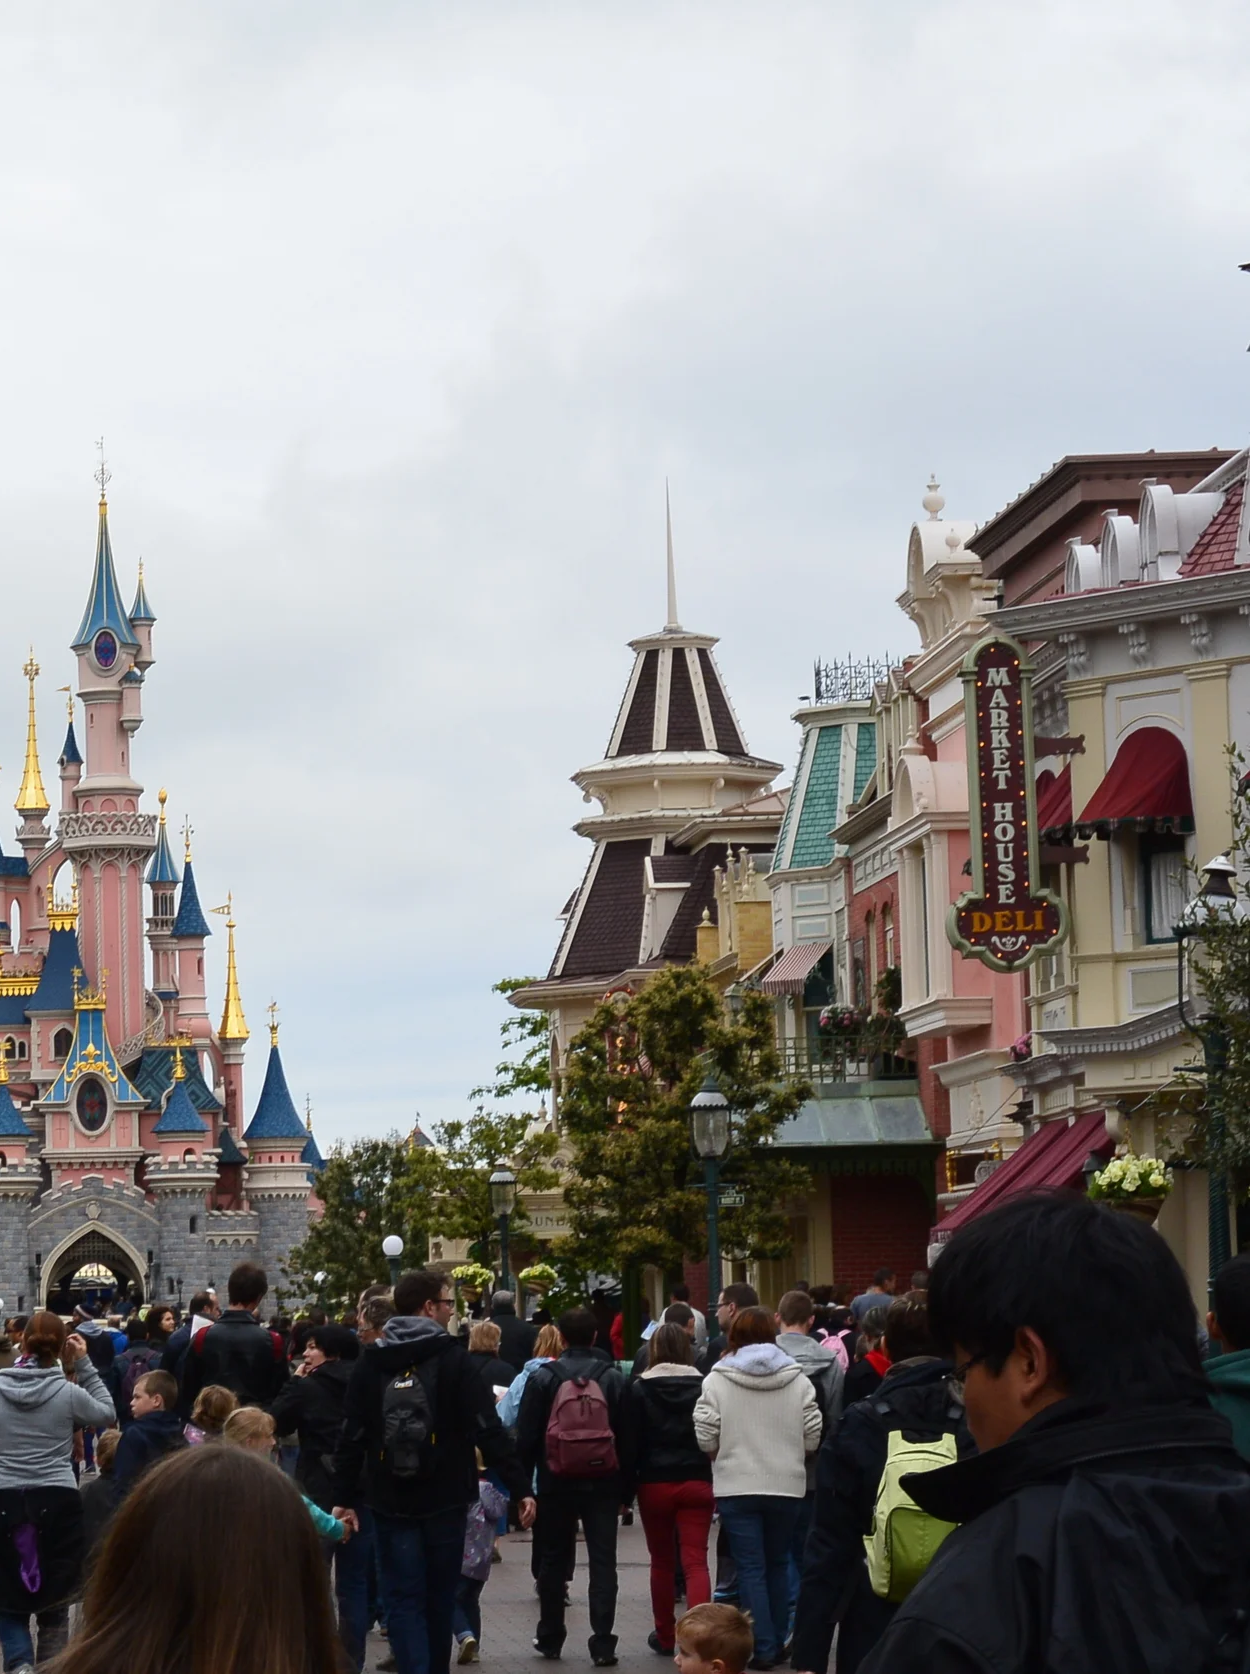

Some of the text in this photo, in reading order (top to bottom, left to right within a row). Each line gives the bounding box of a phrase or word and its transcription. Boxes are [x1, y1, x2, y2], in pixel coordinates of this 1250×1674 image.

[986, 667, 1016, 905] MARKET HOUSE
[971, 910, 1045, 934] DELI
